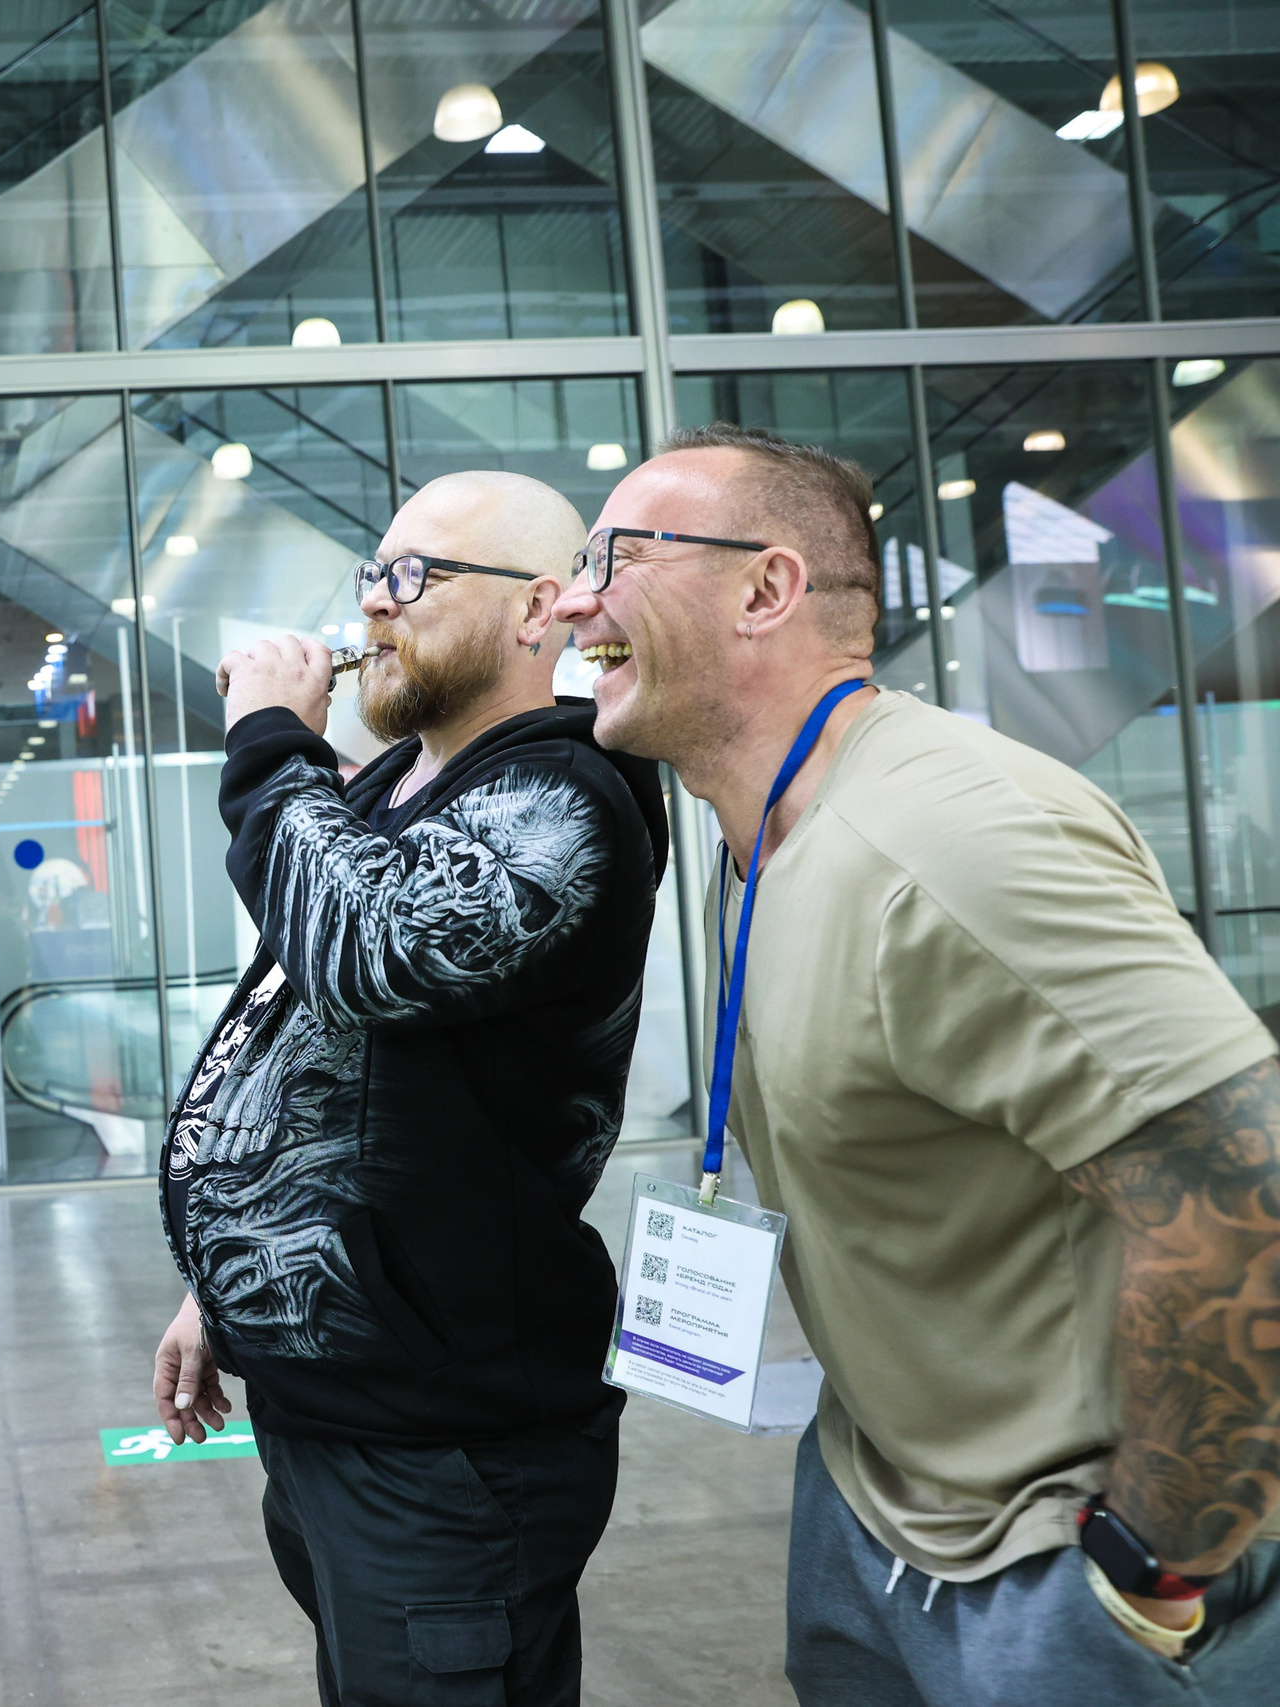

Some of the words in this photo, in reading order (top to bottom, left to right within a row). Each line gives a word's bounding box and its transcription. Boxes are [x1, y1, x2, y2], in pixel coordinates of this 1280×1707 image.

[682, 1225, 718, 1239] КАТАЛОГ
[677, 1265, 736, 1288] ГОЛОСОВАНИЕ
[670, 1315, 729, 1338] МЕРОПРИЯТИЯ
[671, 1308, 720, 1328] ПРОГРАММА
